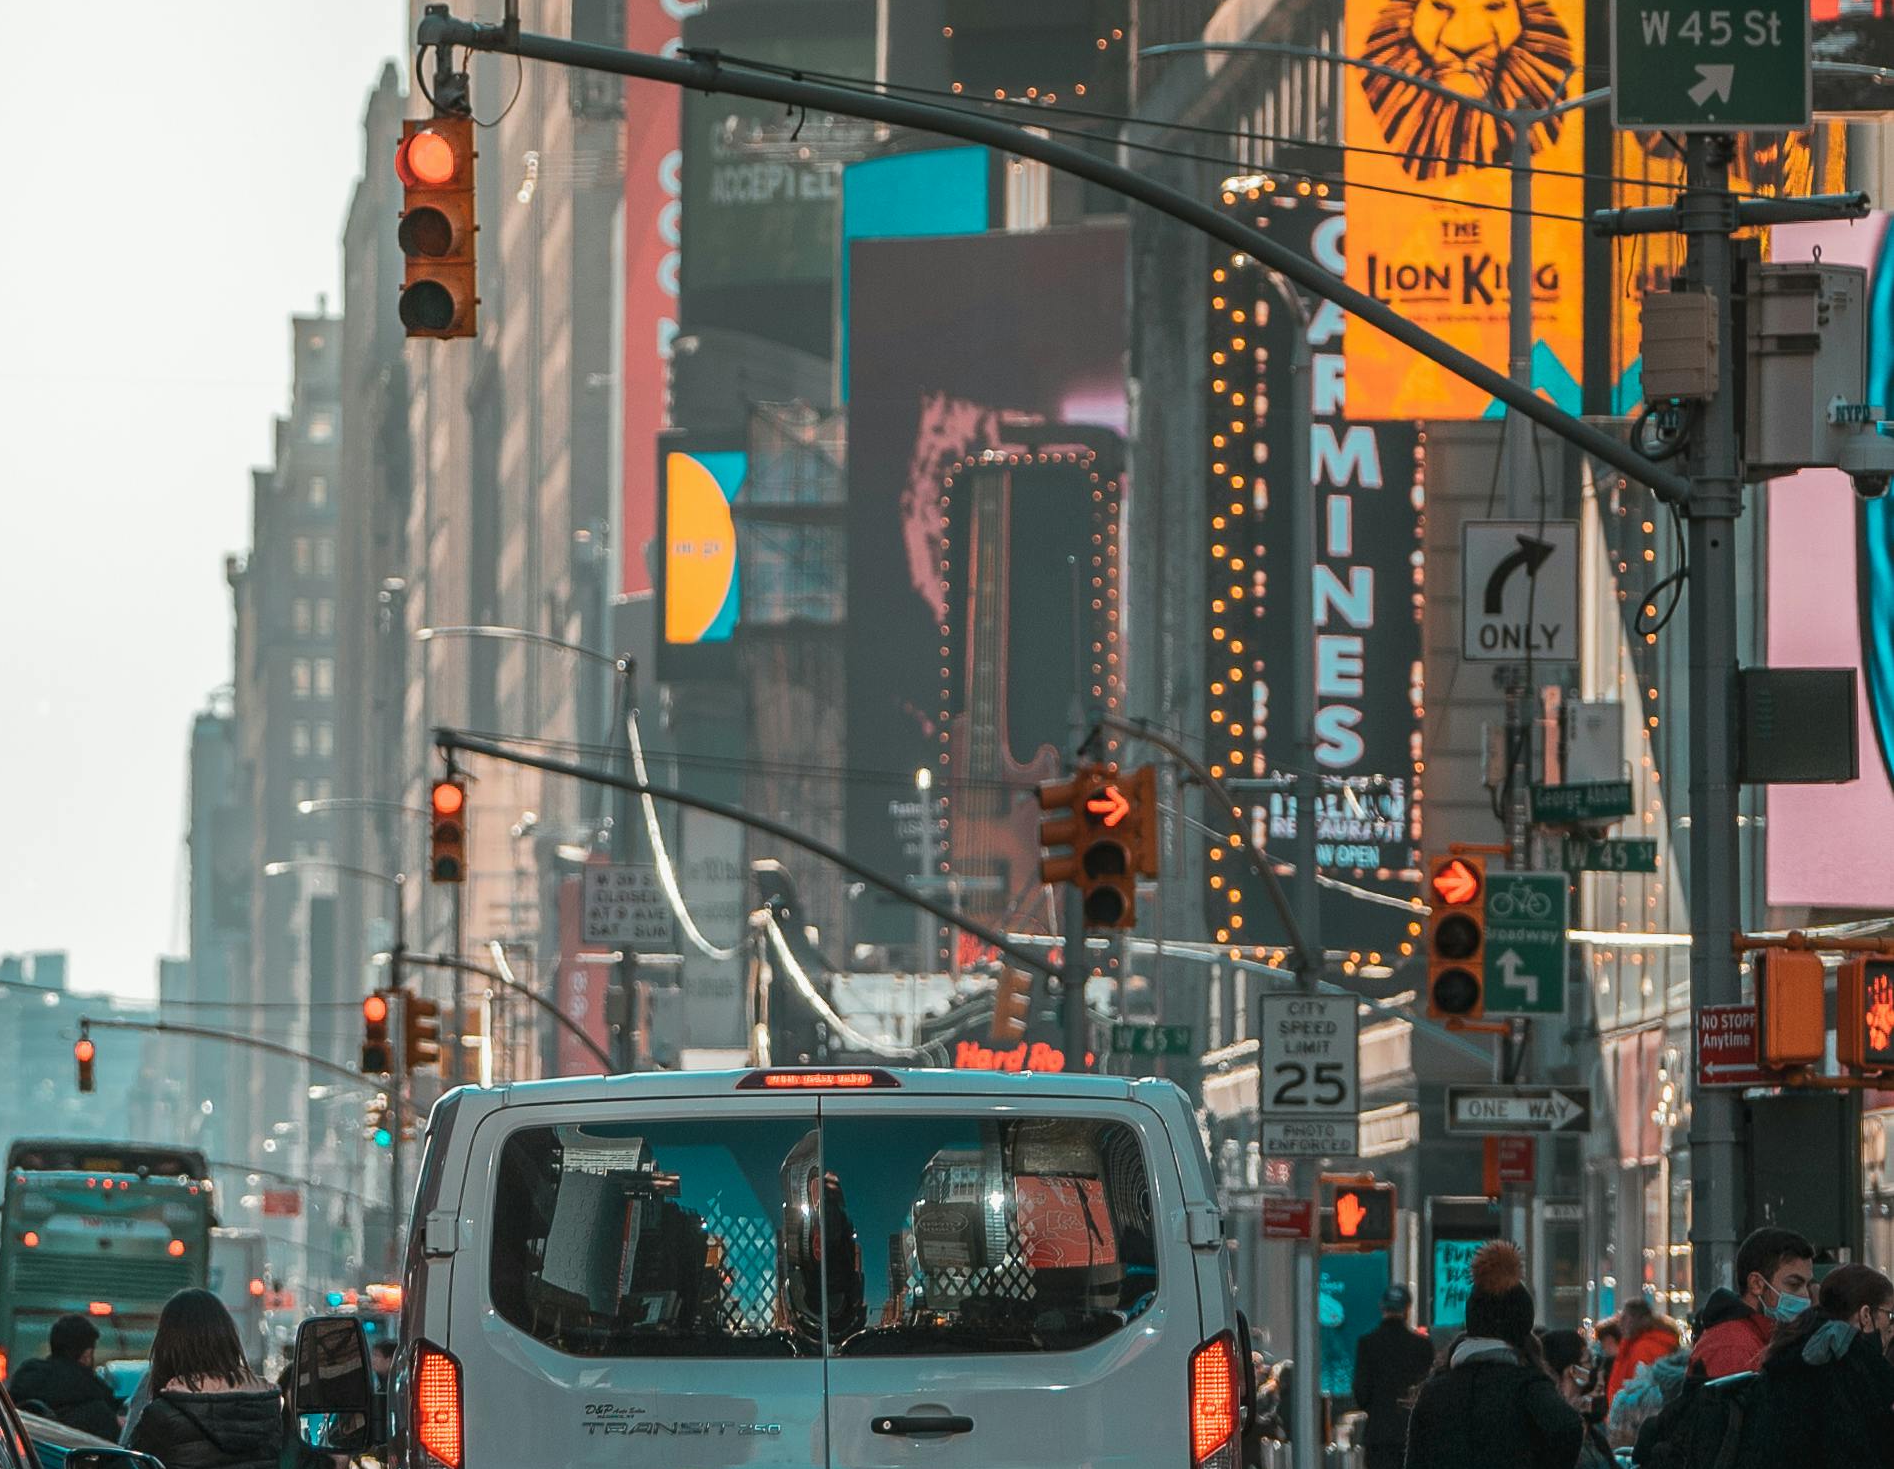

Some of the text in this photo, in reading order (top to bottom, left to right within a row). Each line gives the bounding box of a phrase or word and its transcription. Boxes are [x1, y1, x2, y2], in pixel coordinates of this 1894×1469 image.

[1640, 9, 1782, 47] W 45 St
[1442, 220, 1481, 238] THE
[1479, 623, 1561, 650] ONLY
[1335, 844, 1381, 869] OPEN
[1569, 841, 1588, 867] W
[1600, 843, 1628, 868] 45
[1289, 1002, 1325, 1015] CITY
[1279, 1020, 1338, 1036] SPEED
[1702, 1014, 1718, 1030] NO
[1283, 1039, 1331, 1054] LIMIT
[1703, 1032, 1750, 1050] Anytime
[956, 1041, 1028, 1071] Hard
[1272, 1063, 1348, 1106] 25
[1467, 1099, 1570, 1117] ONE WAY
[1268, 1137, 1353, 1152] ENFORCED
[582, 1421, 736, 1436] TRANSIT
